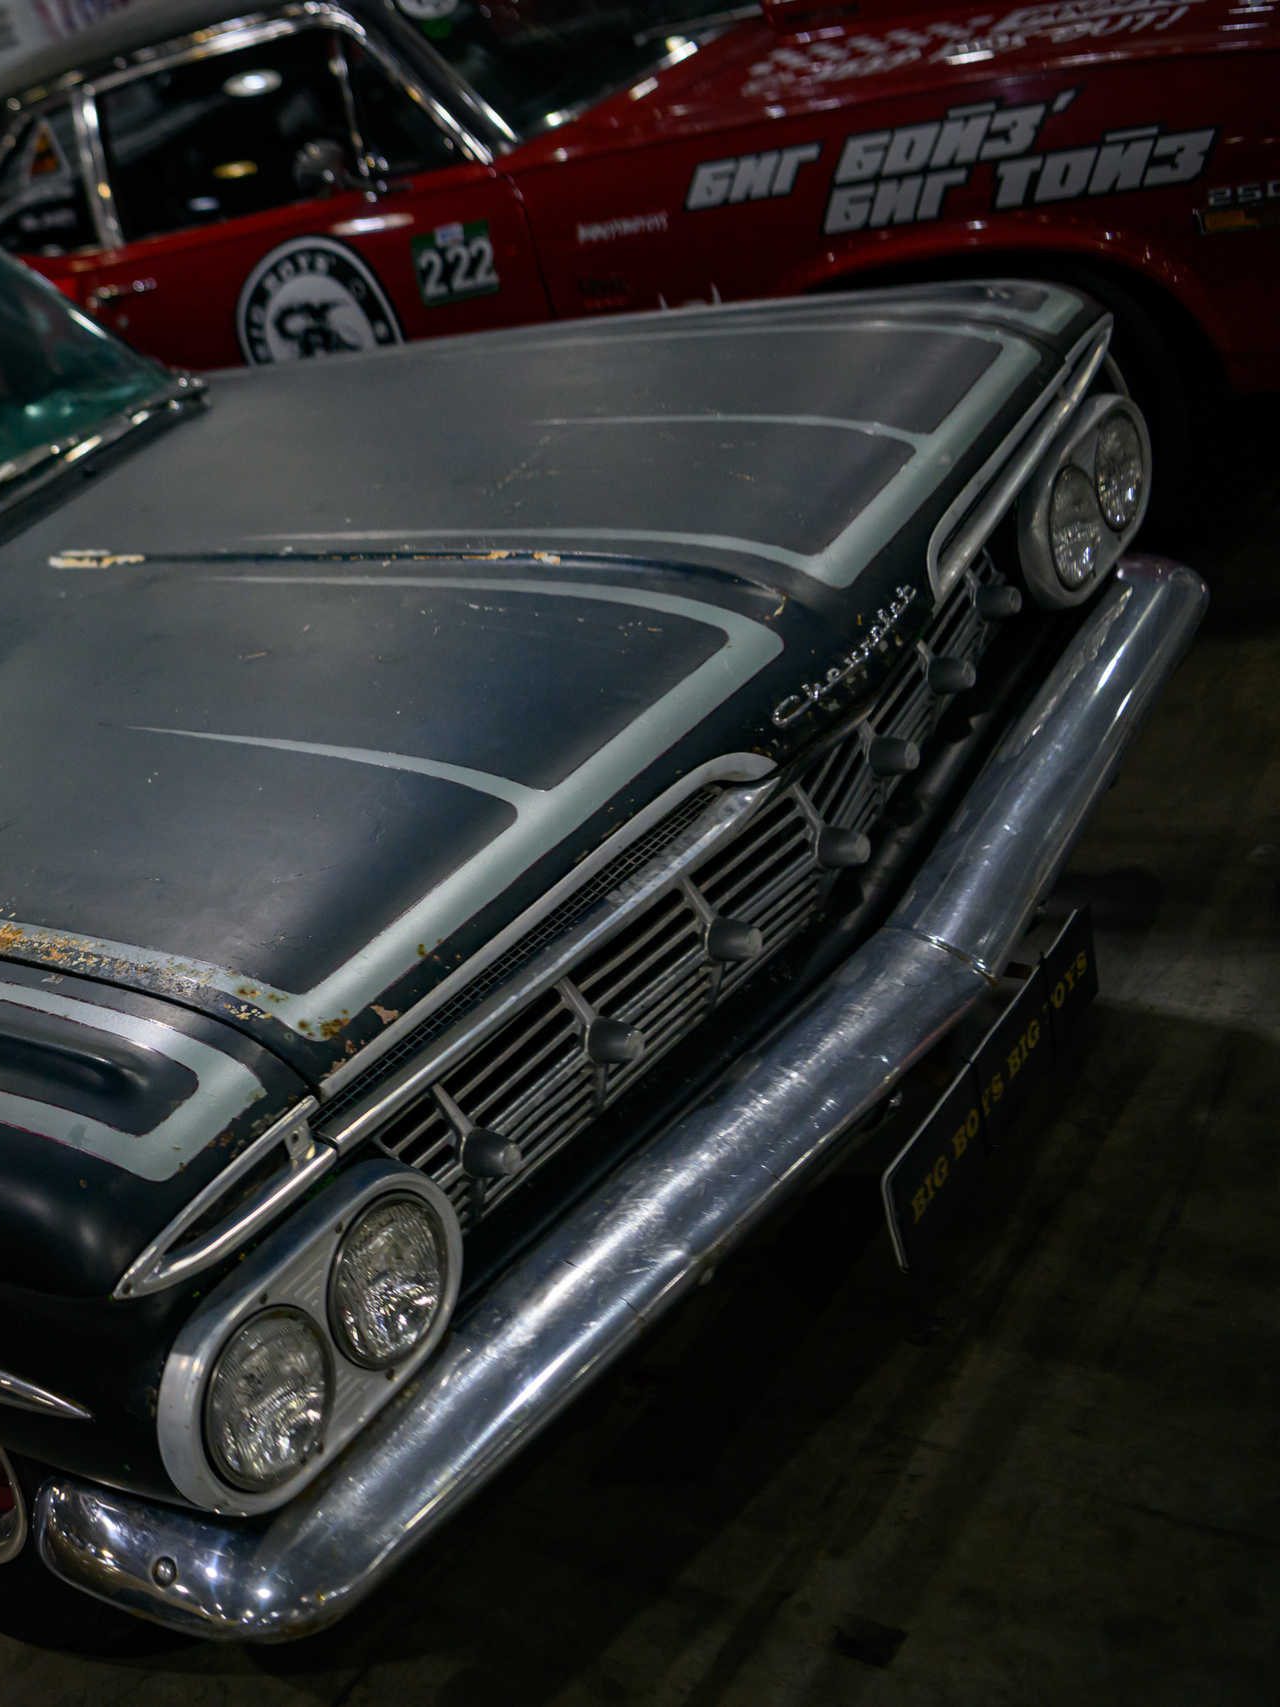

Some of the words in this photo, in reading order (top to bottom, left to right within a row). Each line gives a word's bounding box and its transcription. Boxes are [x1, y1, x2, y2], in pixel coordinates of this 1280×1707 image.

[685, 142, 820, 210] БИГ
[823, 166, 969, 234] БИГ
[994, 125, 1216, 209] ТОЙЗ
[419, 236, 500, 297] 222
[772, 583, 918, 728] Chevrolet
[910, 1155, 950, 1225] BIG
[950, 1072, 1005, 1162] BOYS
[1007, 1018, 1041, 1081] BIG
[1042, 949, 1089, 1026] OYS
